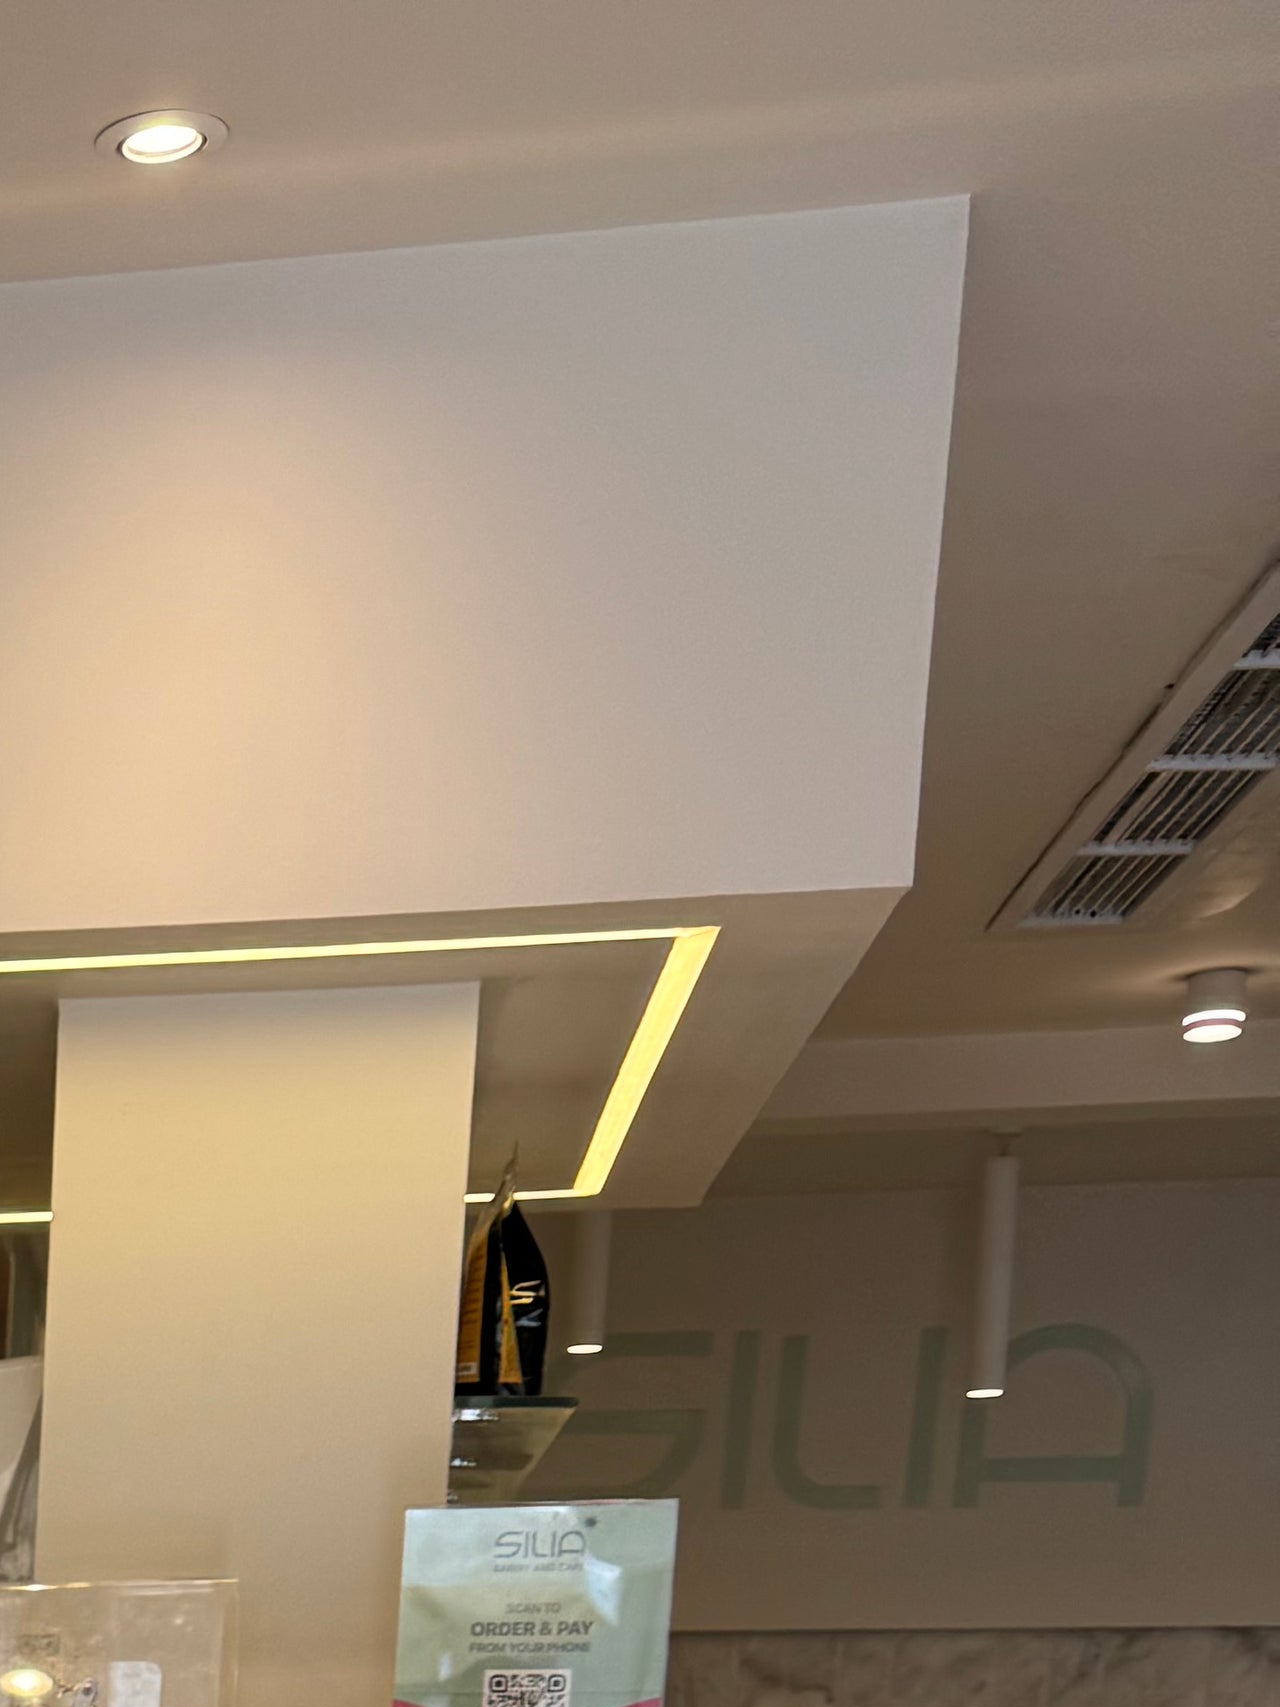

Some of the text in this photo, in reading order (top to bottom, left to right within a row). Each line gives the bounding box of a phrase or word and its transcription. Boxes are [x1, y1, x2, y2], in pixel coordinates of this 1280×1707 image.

[536, 1322, 1154, 1511] SILIA
[493, 1530, 586, 1558] SILIA
[505, 1602, 562, 1614] SCAN TO
[470, 1620, 594, 1637] ORDER & PAY
[468, 1642, 591, 1653] FROM YOUR PHONE
